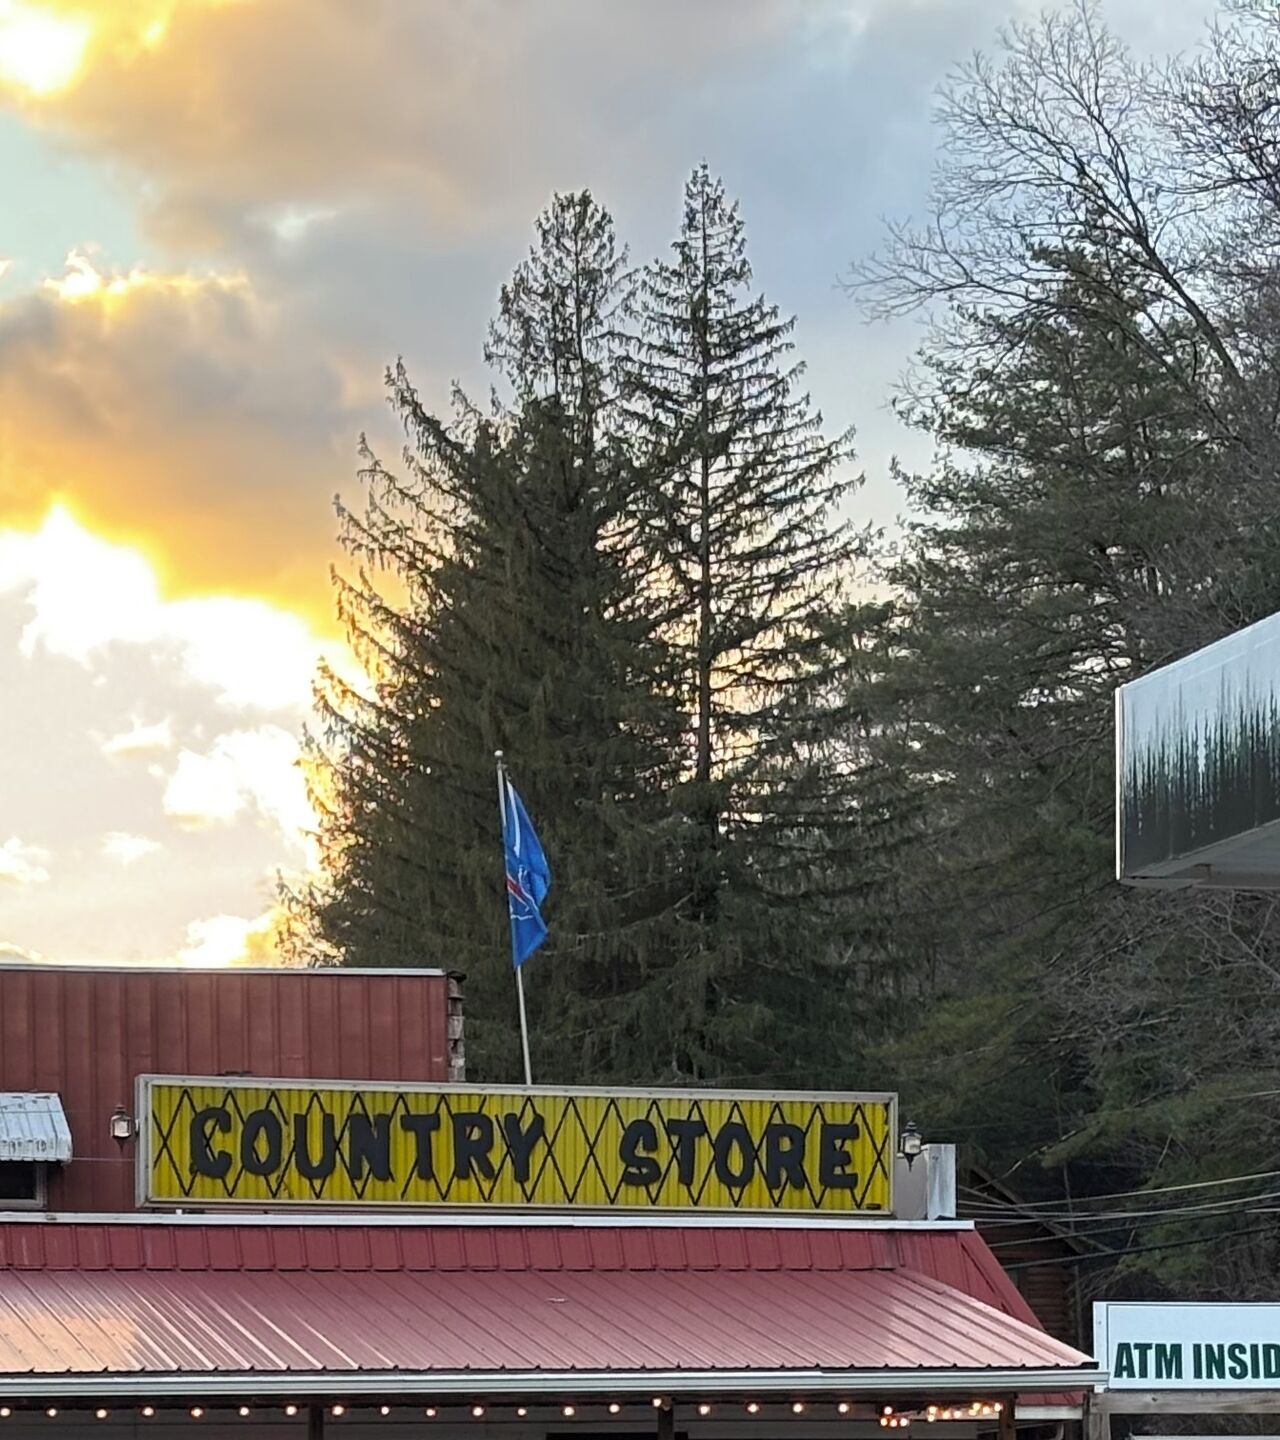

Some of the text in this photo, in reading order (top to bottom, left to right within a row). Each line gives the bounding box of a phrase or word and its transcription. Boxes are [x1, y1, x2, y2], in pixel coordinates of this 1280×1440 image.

[190, 1106, 861, 1190] COUNTRY STORE
[1113, 1342, 1183, 1380] ATM
